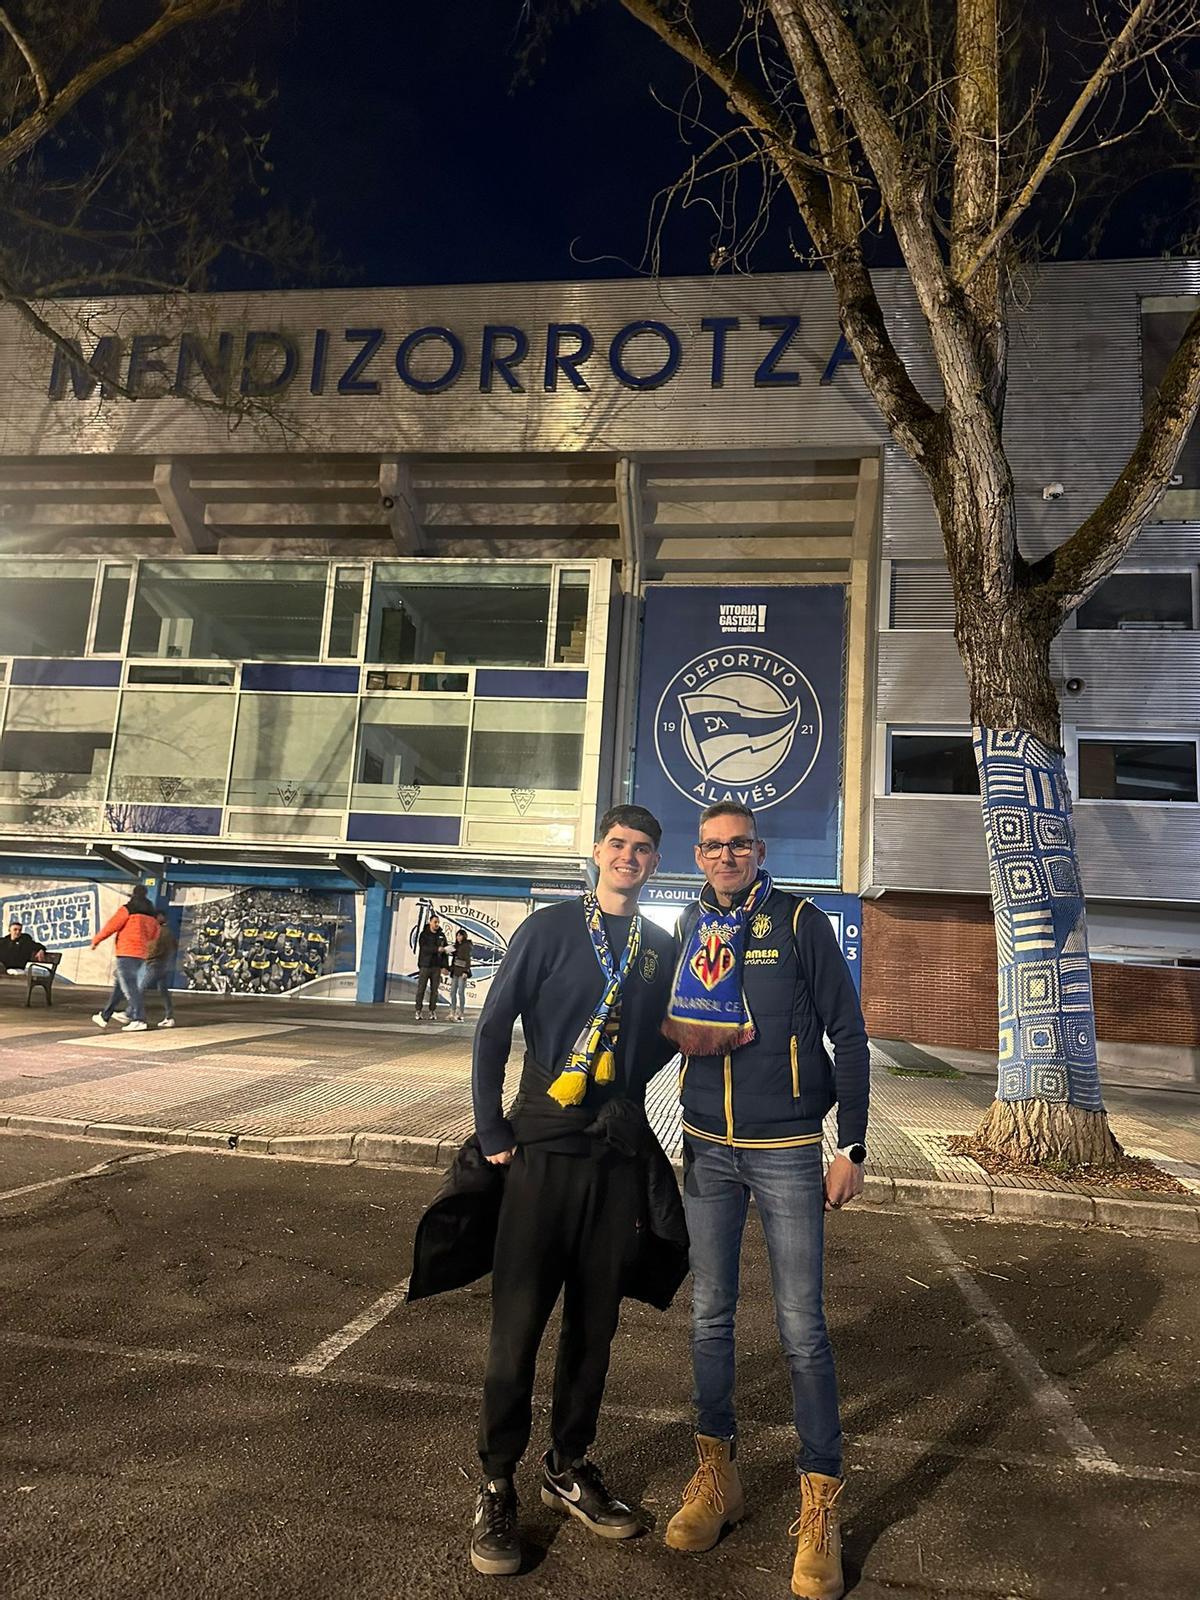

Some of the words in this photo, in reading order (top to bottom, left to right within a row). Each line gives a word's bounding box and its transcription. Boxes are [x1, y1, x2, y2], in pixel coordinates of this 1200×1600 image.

[720, 604, 757, 615] VITORIA
[719, 615, 757, 625] GASTEIZ
[683, 653, 797, 687] DEPORTIVO
[663, 722, 676, 732] 19
[801, 725, 814, 735] 21
[693, 782, 776, 804] ALAVÉS
[648, 889, 700, 901] TAQUILL
[10, 903, 91, 925] AGAINST
[439, 904, 500, 928] DEPORTIVO
[745, 949, 779, 959] AMESA
[846, 946, 858, 960] 3
